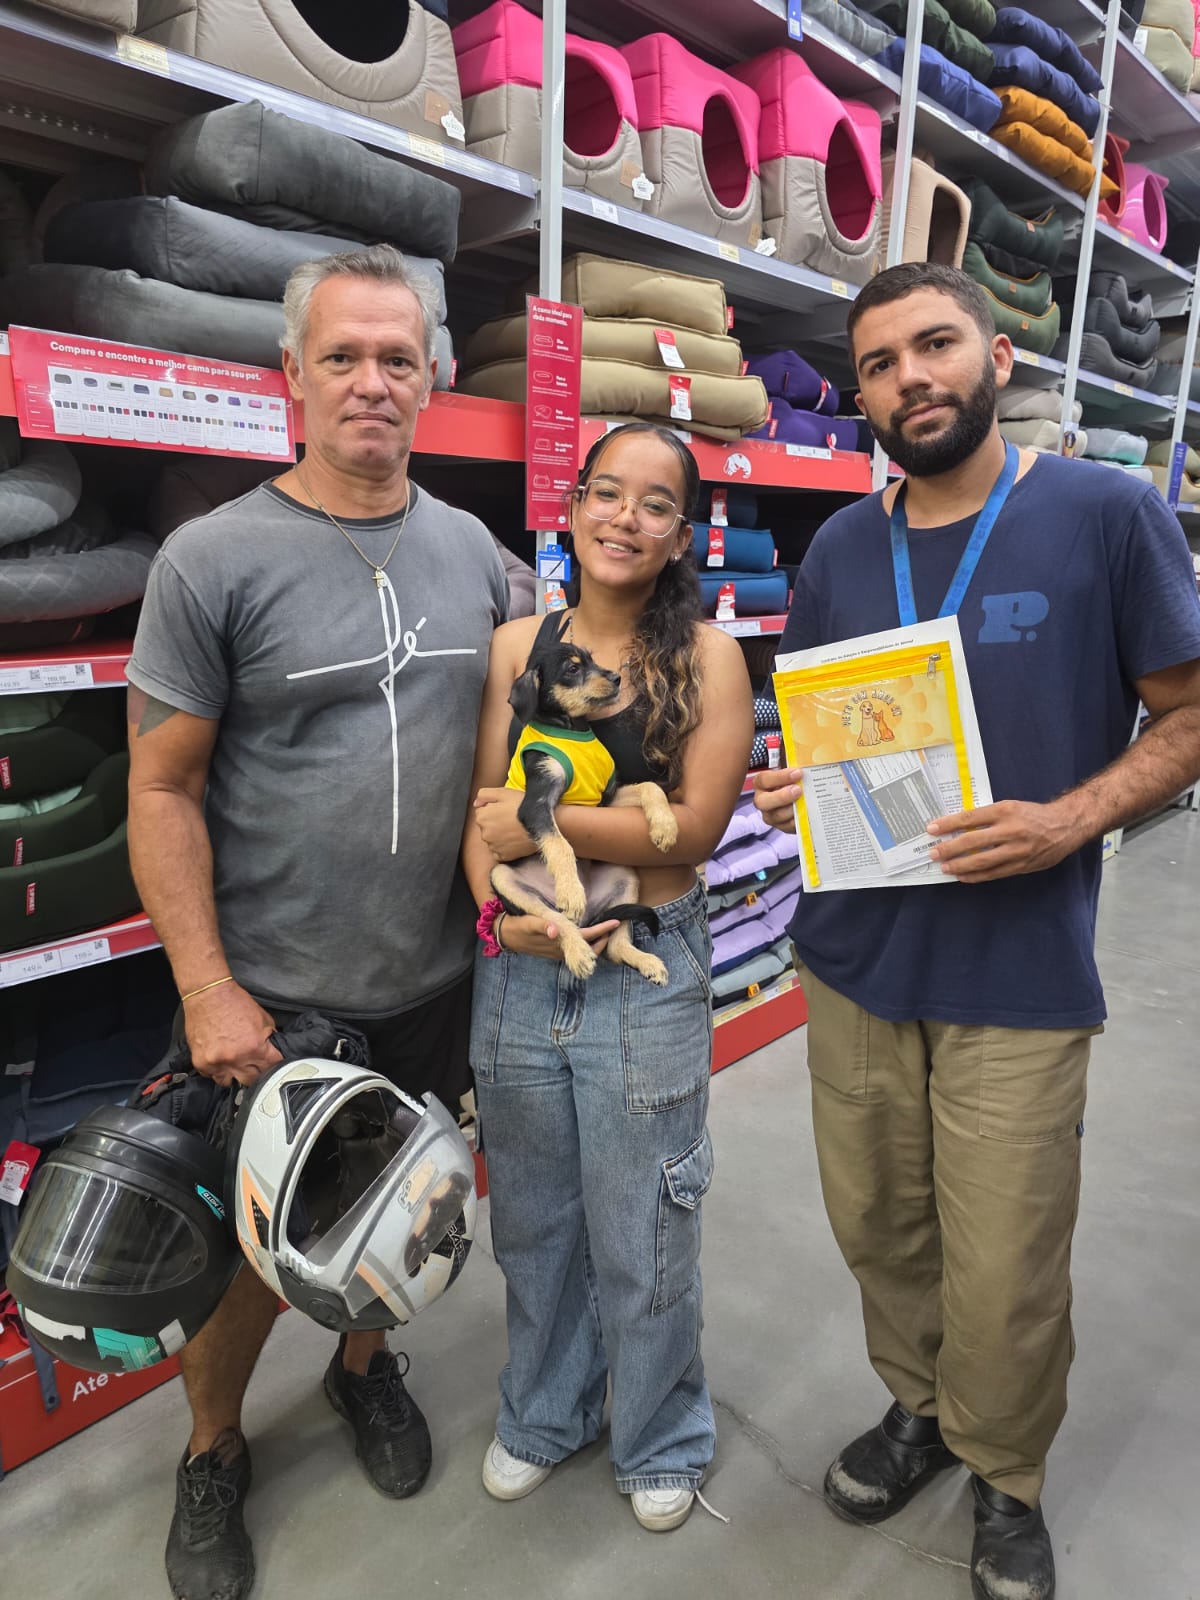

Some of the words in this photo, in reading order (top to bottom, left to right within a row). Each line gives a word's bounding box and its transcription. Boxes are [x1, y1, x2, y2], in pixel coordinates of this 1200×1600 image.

[50, 341, 96, 357] Compare
[97, 350, 104, 358] e
[105, 350, 147, 365] encontre
[155, 359, 186, 371] melhor
[187, 363, 210, 374] cama
[211, 367, 230, 378] para
[231, 370, 245, 379] seu
[245, 370, 262, 381] pet.
